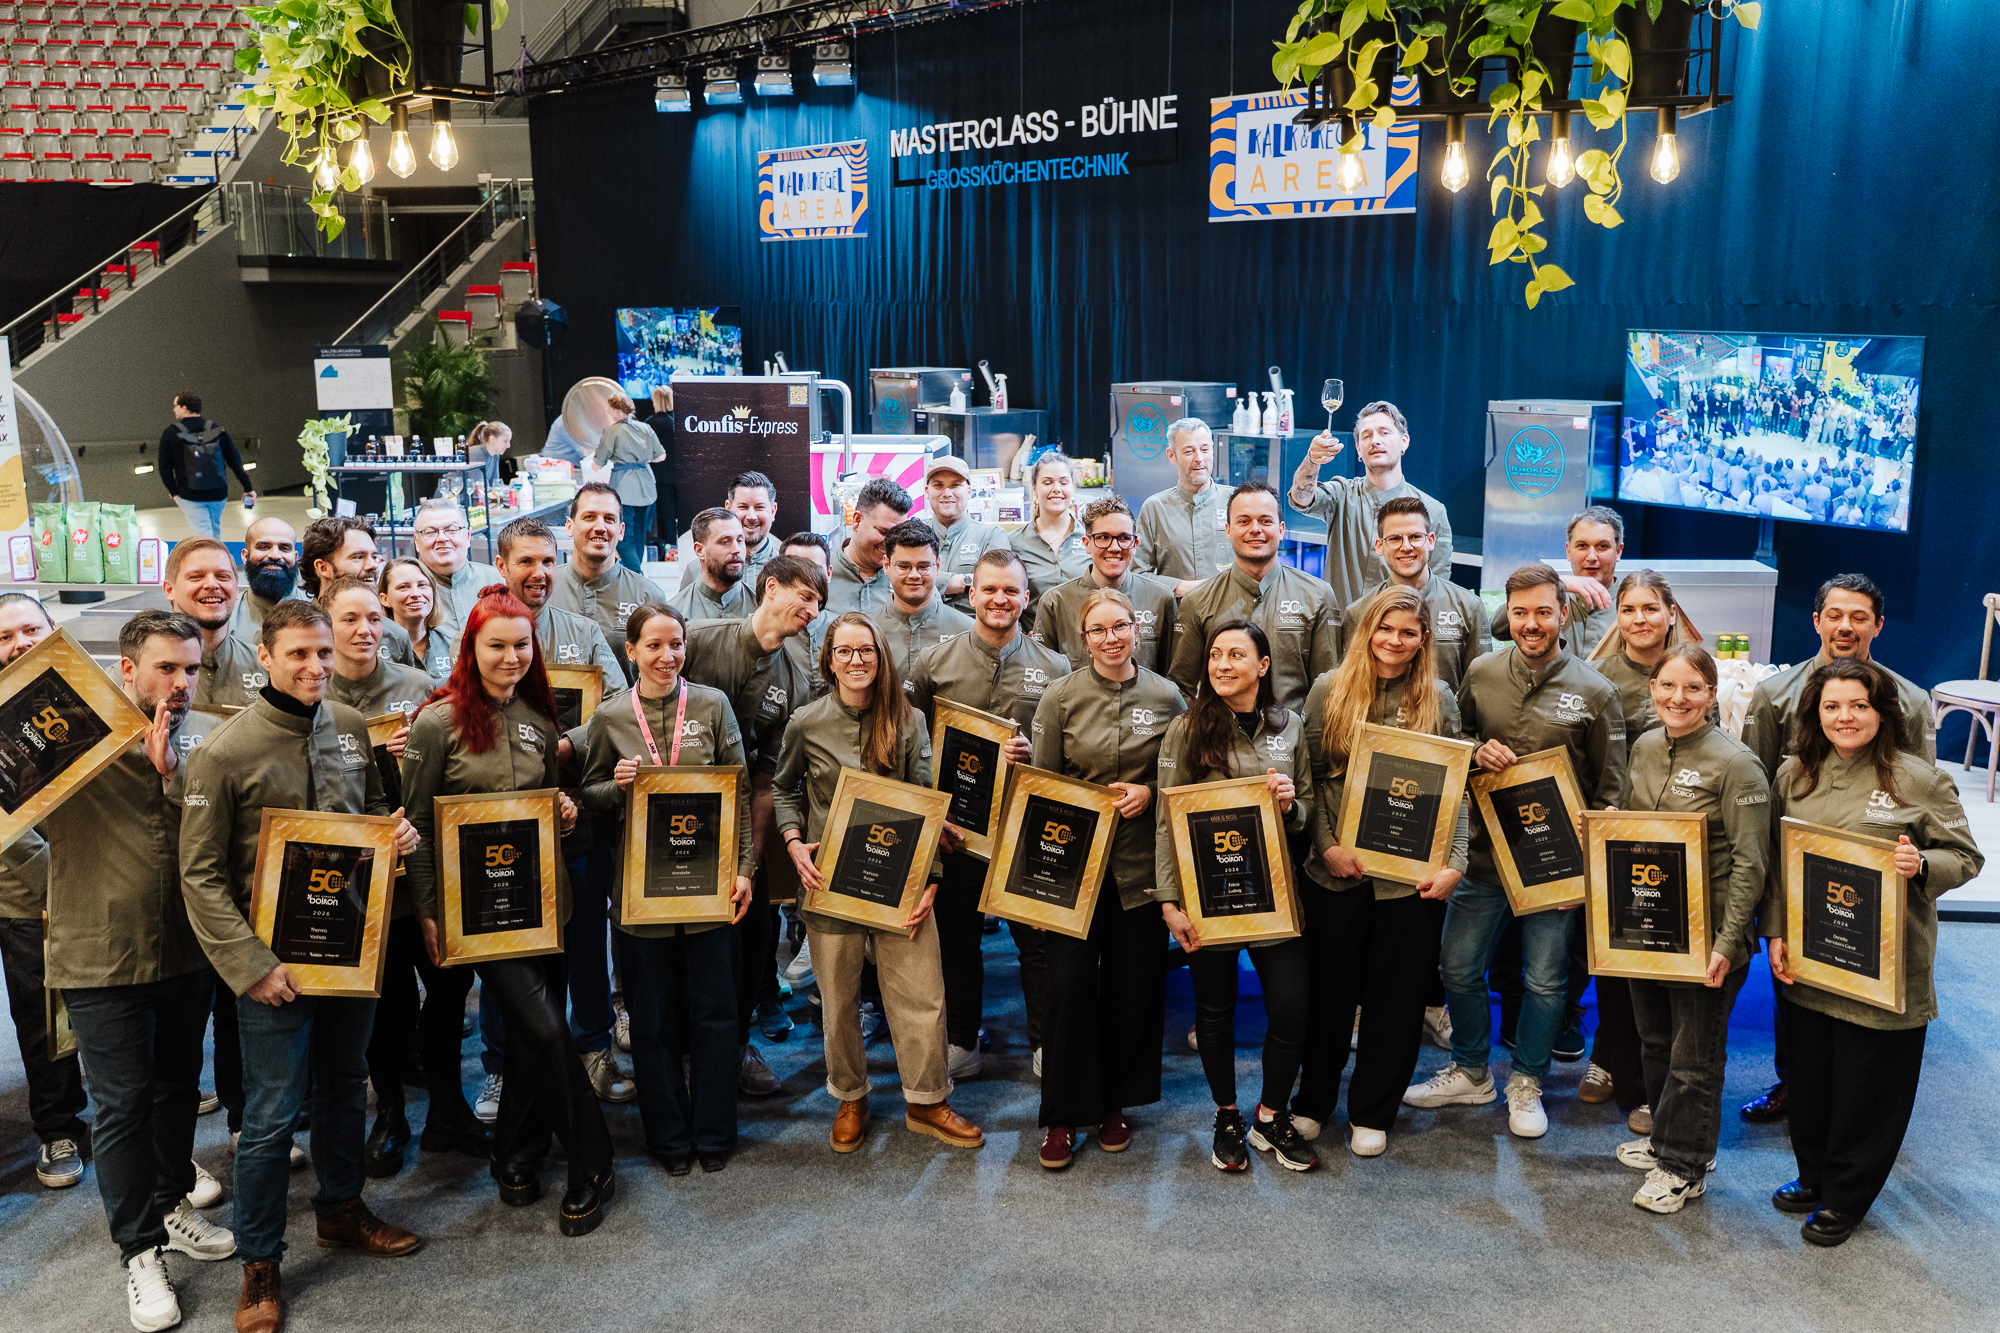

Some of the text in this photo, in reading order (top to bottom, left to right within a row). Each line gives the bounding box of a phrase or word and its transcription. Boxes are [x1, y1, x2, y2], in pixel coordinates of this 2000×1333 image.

[890, 109, 1059, 158] MASTERCLASS
[1081, 95, 1178, 138] BÜHNE
[926, 152, 1130, 190] GROSSKÜCHENTECHNIK
[781, 197, 844, 221] AREA
[684, 414, 798, 438] Confis-Express
[960, 543, 978, 554] 50
[108, 554, 121, 562] BIO
[1279, 600, 1301, 614] 50
[1437, 611, 1459, 625] 50
[558, 644, 580, 659] 50
[242, 673, 265, 689] 50
[1024, 668, 1046, 683] 50
[765, 685, 787, 704] 50
[1558, 693, 1584, 711] 50
[32, 705, 69, 740] 50
[1132, 708, 1154, 725] 50
[518, 724, 536, 741] 50
[179, 735, 203, 750] 50
[337, 734, 356, 751] 50
[1267, 735, 1285, 751] 50
[957, 751, 979, 774] 50
[1674, 768, 1700, 786] 50
[1389, 777, 1418, 799] 50
[1389, 800, 1414, 810] boiron
[1868, 790, 1896, 809] 50
[1518, 802, 1546, 825] 50
[669, 814, 698, 835] 50
[1041, 821, 1071, 845] 50
[672, 838, 695, 846] boiron
[867, 824, 897, 847] 50
[1214, 830, 1242, 853] 50
[485, 844, 515, 867] 50
[867, 856, 882, 864] 2026
[1218, 855, 1243, 863] boiron
[308, 869, 343, 893] 50
[488, 869, 515, 878] boiron
[1631, 863, 1661, 886] 50
[309, 897, 338, 906] boiron
[1634, 890, 1661, 898] boiron
[1826, 881, 1856, 907] 50
[1828, 907, 1855, 920] boiron
[1833, 919, 1848, 927] 2026
